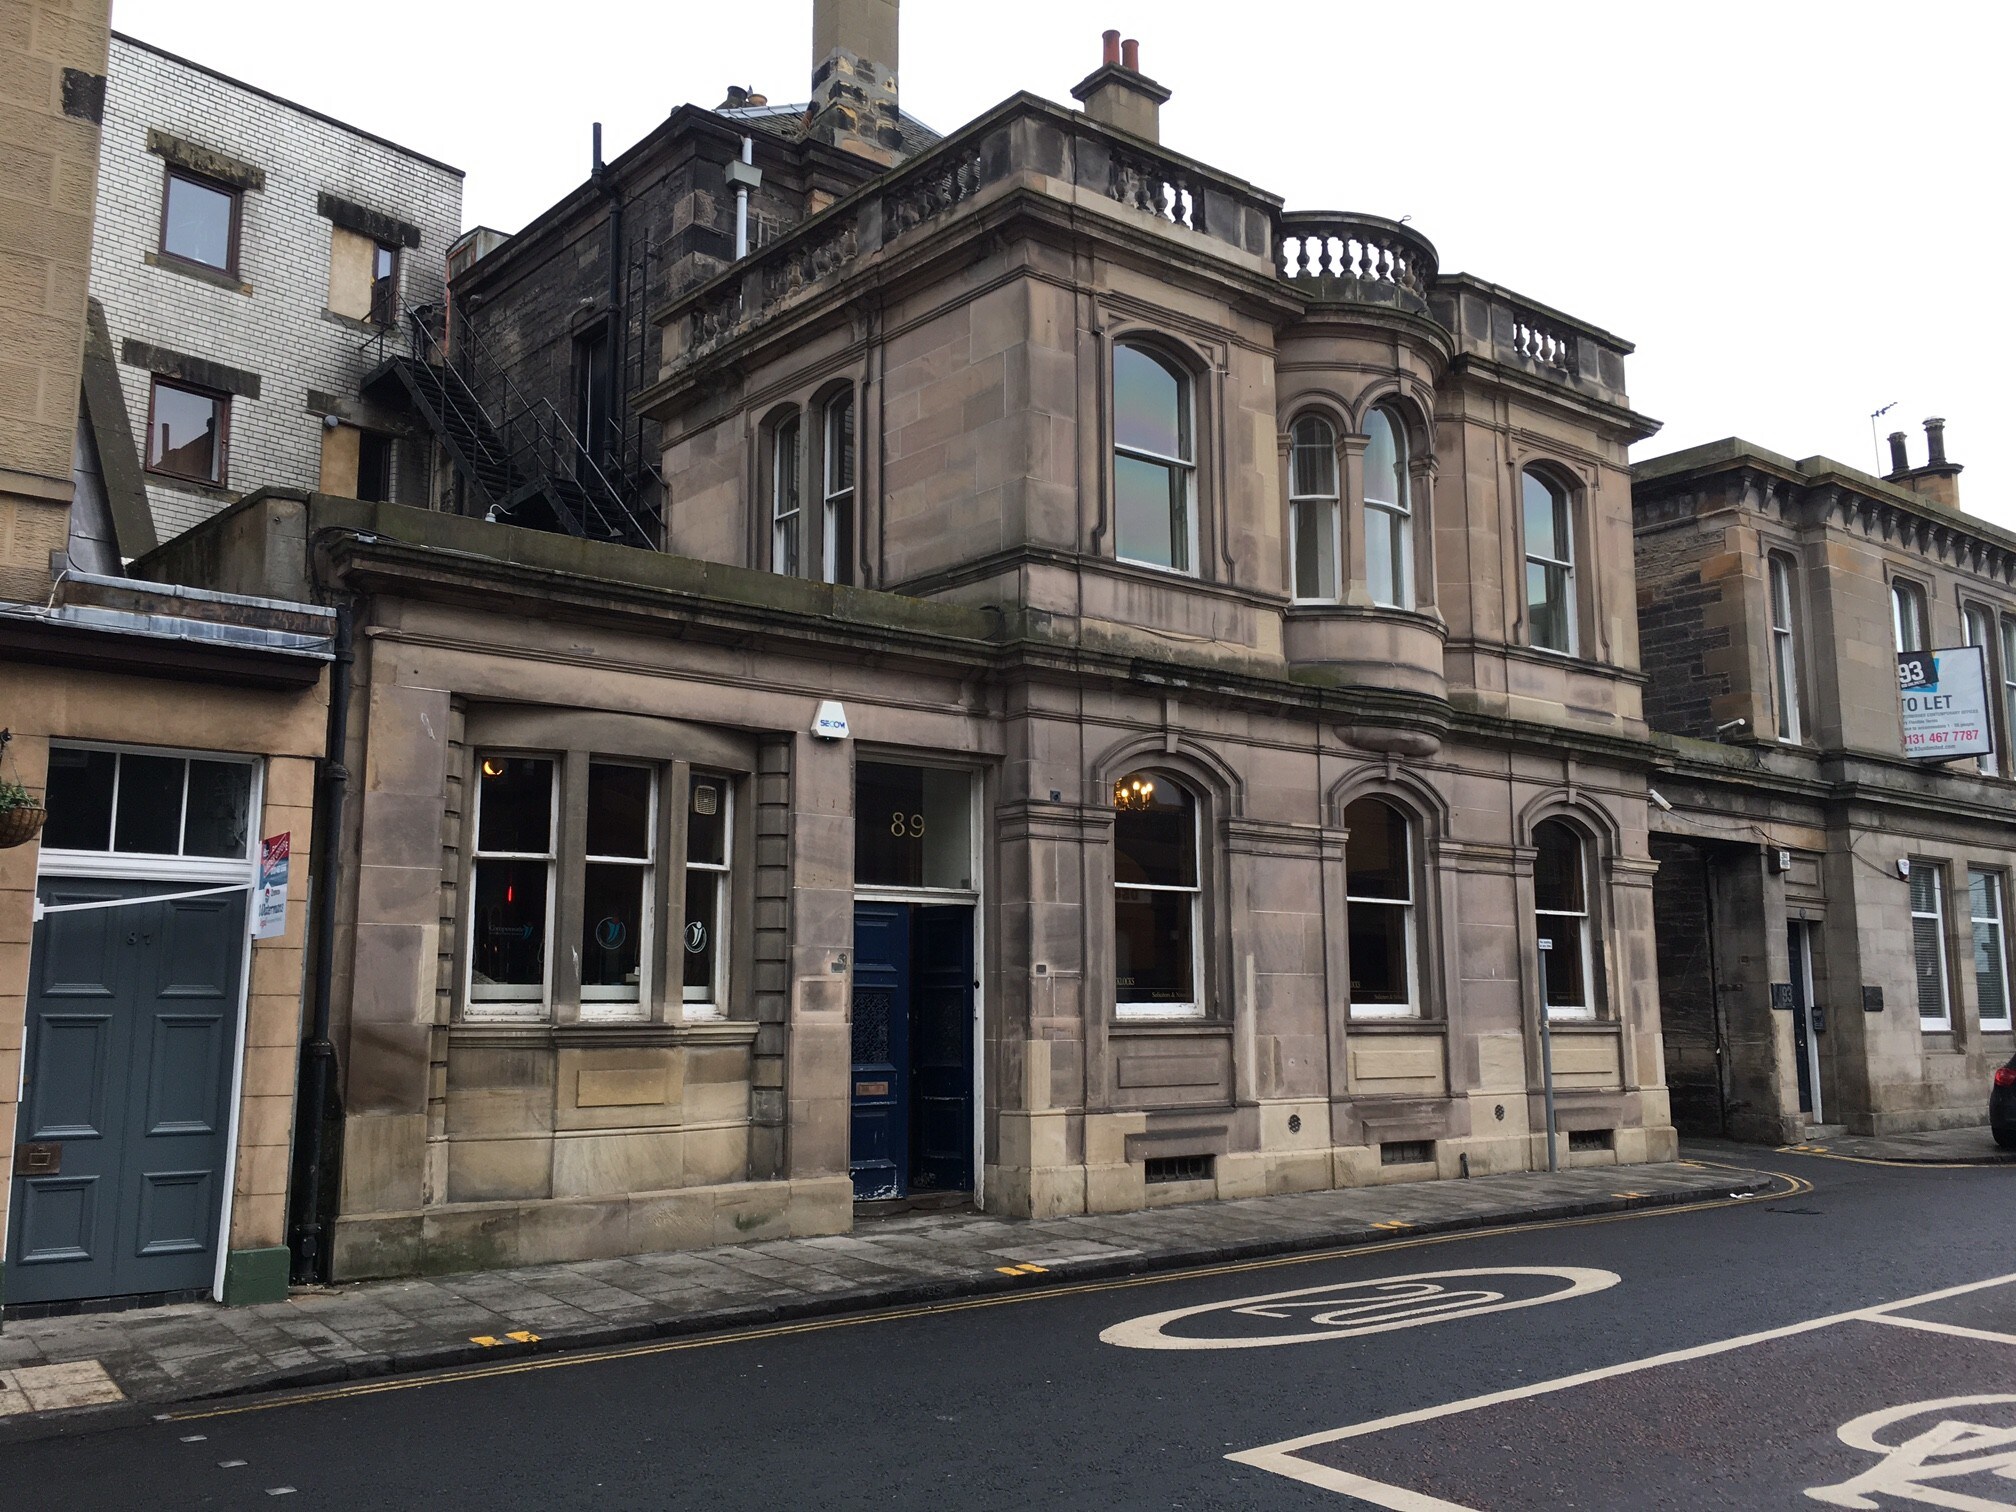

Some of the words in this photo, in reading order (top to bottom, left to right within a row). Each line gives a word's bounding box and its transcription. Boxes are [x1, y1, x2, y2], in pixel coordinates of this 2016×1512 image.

[1898, 661, 1924, 683] 93
[1924, 695, 1952, 710] LET
[820, 719, 846, 729] SECOM
[1929, 731, 1949, 743] 467
[1952, 729, 1979, 742] 7787
[890, 812, 926, 838] 89
[1231, 1283, 1505, 1325] 20
